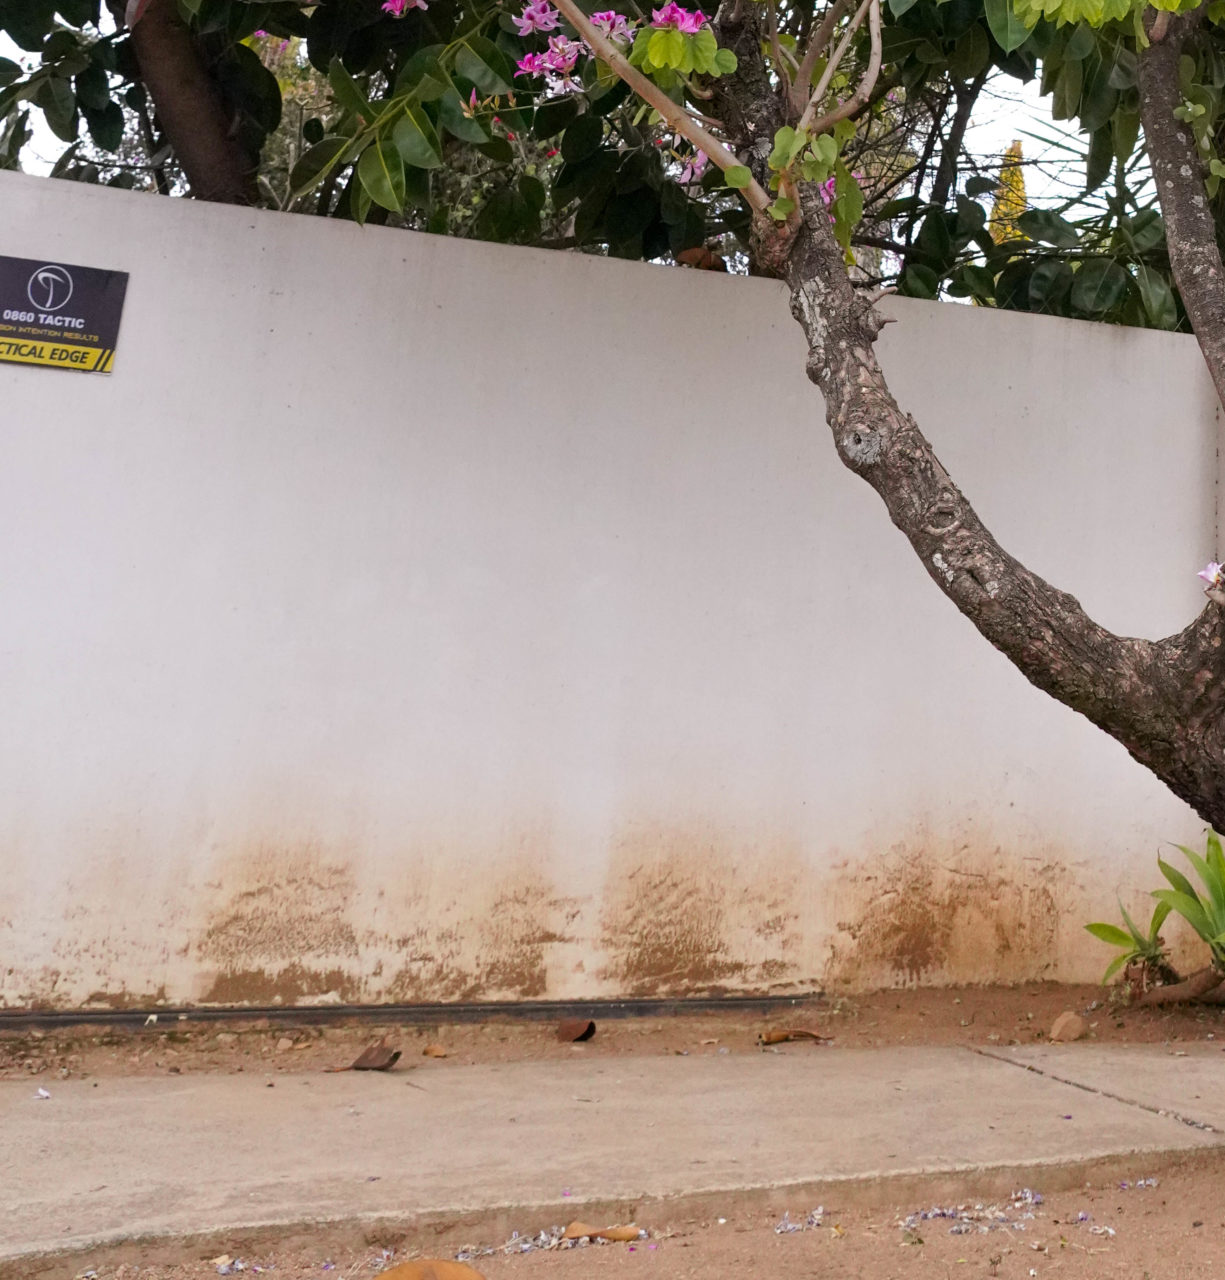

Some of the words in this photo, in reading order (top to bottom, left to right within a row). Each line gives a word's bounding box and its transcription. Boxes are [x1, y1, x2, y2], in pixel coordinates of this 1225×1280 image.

[3, 309, 35, 322] 0860
[38, 313, 85, 329] TACTIC
[63, 331, 99, 342] RESULTS
[49, 348, 90, 364] EDGE
